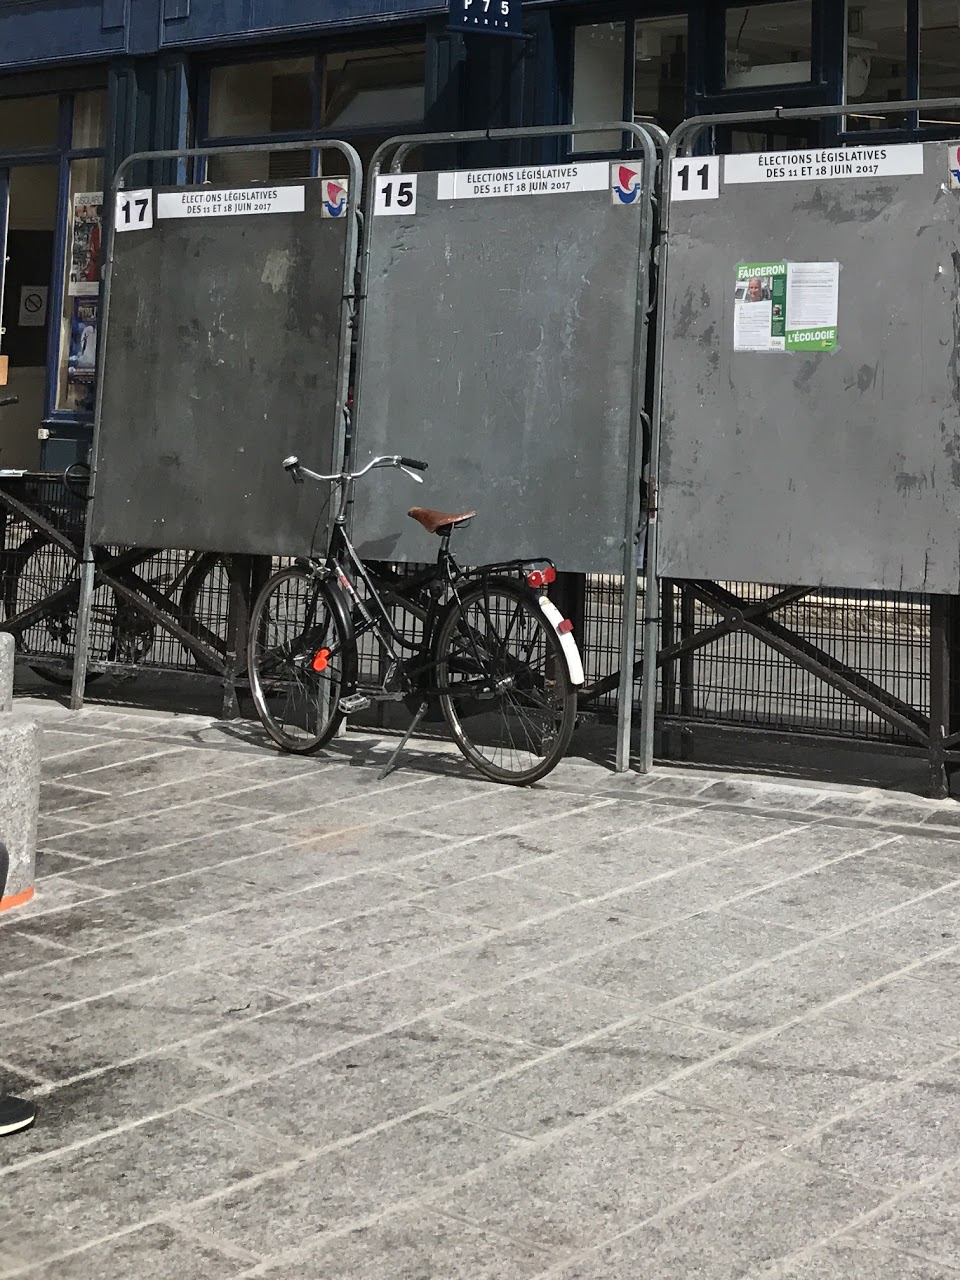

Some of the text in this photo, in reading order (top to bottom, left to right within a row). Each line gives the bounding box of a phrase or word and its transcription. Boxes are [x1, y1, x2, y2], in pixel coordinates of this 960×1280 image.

[463, 16, 509, 28] PARIS
[758, 150, 887, 167] ÉLECTIONS LÉGISLATIVES
[467, 167, 578, 184] ÉLECTIONS LÉGISLATIVES
[677, 163, 709, 191] 11
[766, 164, 879, 178] DES 11 ET 18 JUIN 2017
[381, 182, 414, 207] 15
[474, 185, 490, 194] DES
[504, 183, 514, 193] ET
[516, 183, 526, 192] 18
[528, 182, 548, 193] JUIN
[551, 181, 571, 191] 2017
[181, 190, 278, 204] ÉLECTONS LÉGISLATIVES
[121, 198, 149, 224] 17
[187, 206, 201, 214] DES
[213, 205, 222, 213] ET
[223, 203, 232, 212] 18
[234, 203, 252, 213] JUIN
[254, 203, 272, 212] 2017
[738, 265, 785, 279] FAUGERON
[787, 330, 835, 343] L'ÉCOLOGIE
